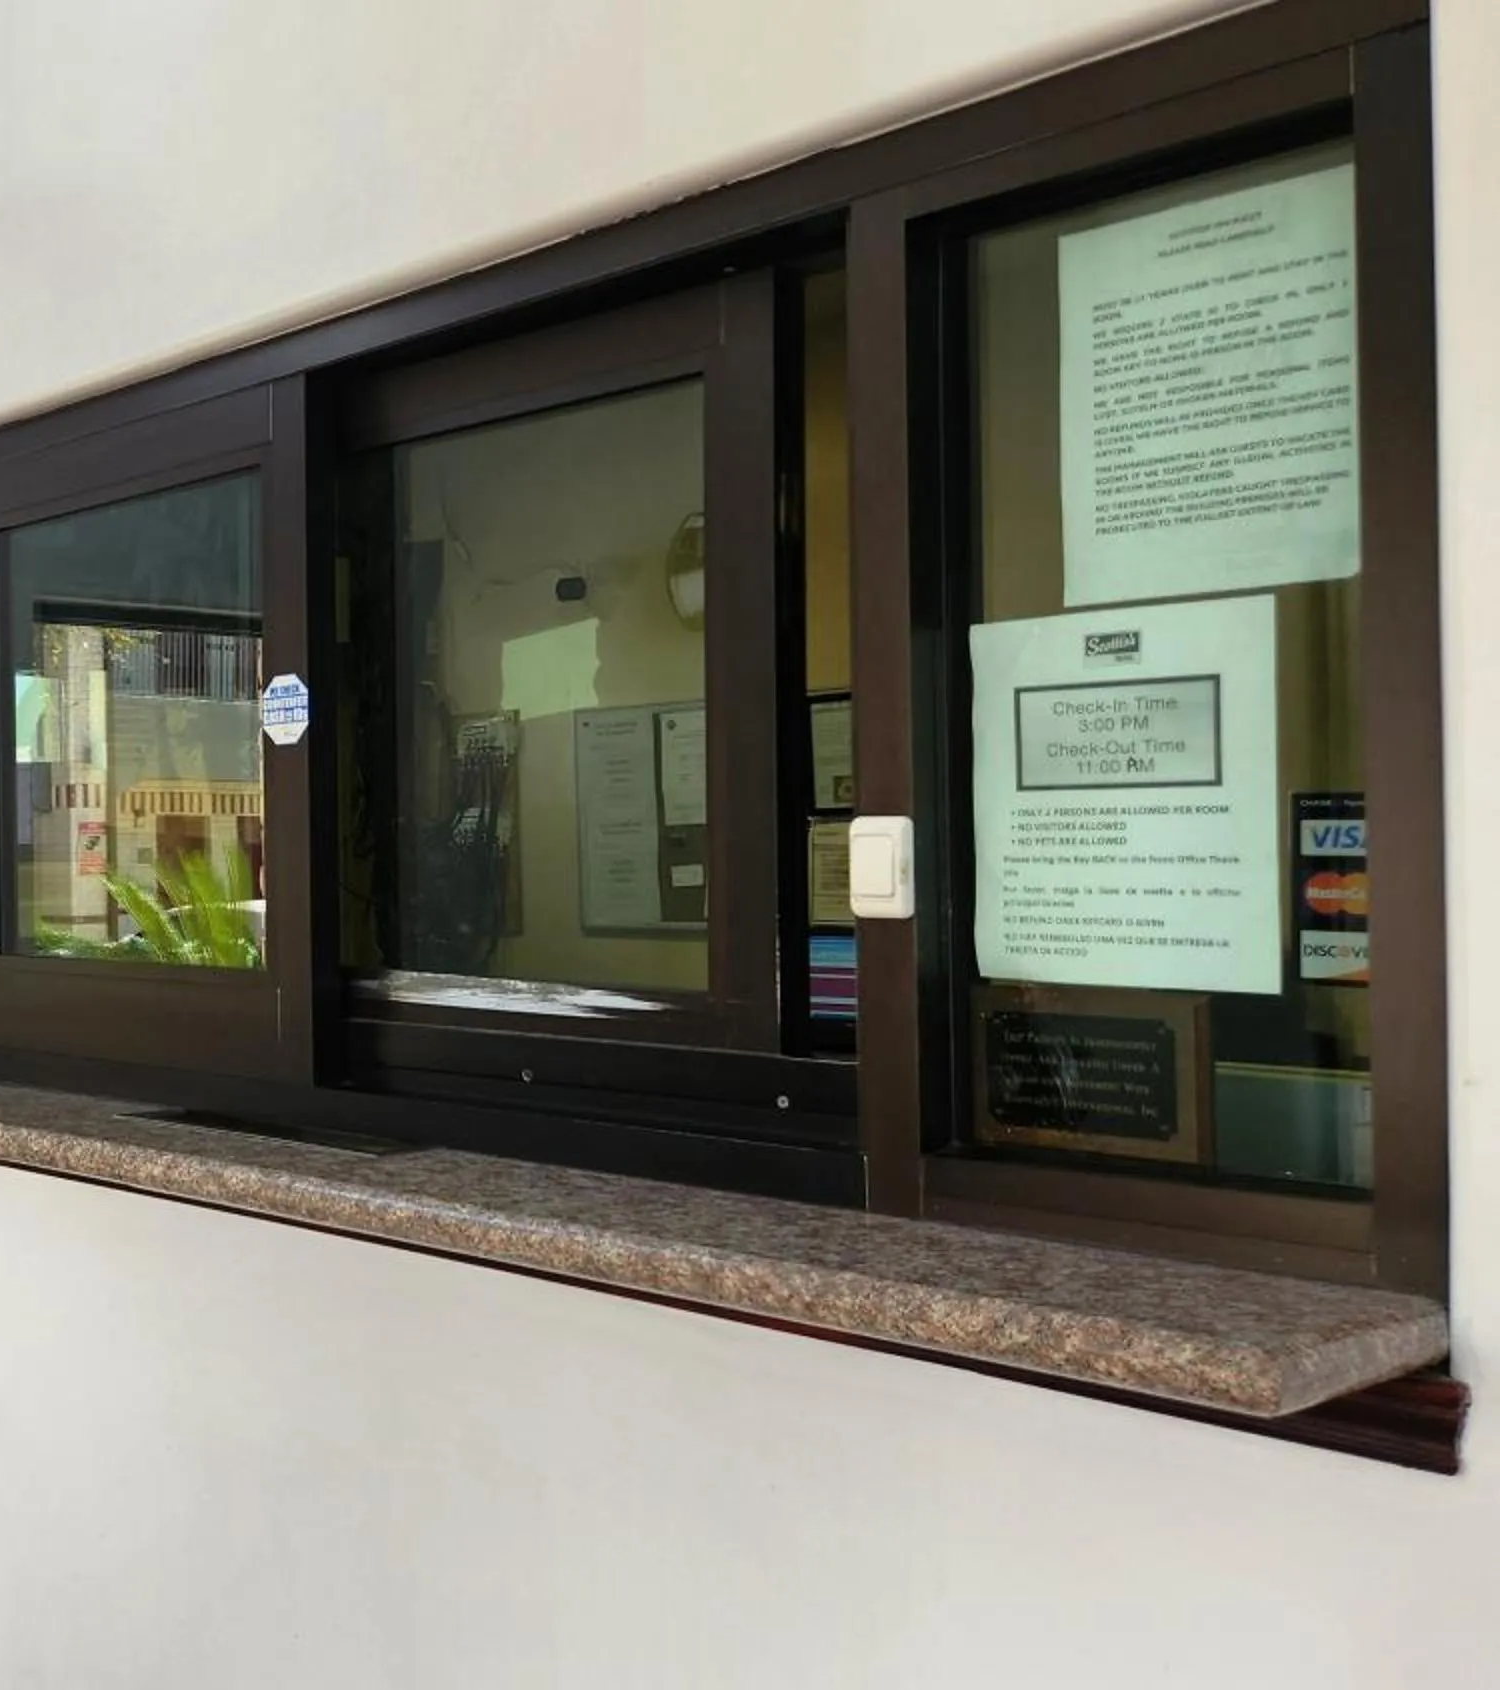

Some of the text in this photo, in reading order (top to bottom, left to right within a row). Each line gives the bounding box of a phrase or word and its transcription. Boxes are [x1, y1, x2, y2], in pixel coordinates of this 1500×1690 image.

[1052, 696, 1179, 717] Check-In Time
[1078, 715, 1150, 733] 3:00 PM
[1046, 738, 1186, 758] Check-Out Time
[1077, 758, 1122, 775] 11:00
[1017, 808, 1043, 817] ONLY
[1052, 807, 1097, 816] PERSONS
[1098, 807, 1118, 816] ARE
[1119, 806, 1170, 815] ALLOWED
[1172, 805, 1192, 814] PER
[1194, 804, 1229, 814] ROOM
[1017, 823, 1033, 831] NO
[1078, 822, 1127, 830] ALLOWED
[1017, 837, 1033, 845] NO
[1078, 836, 1127, 845] ALLOWED
[1312, 825, 1365, 849] VIS
[1303, 943, 1369, 958] DISCOVE
